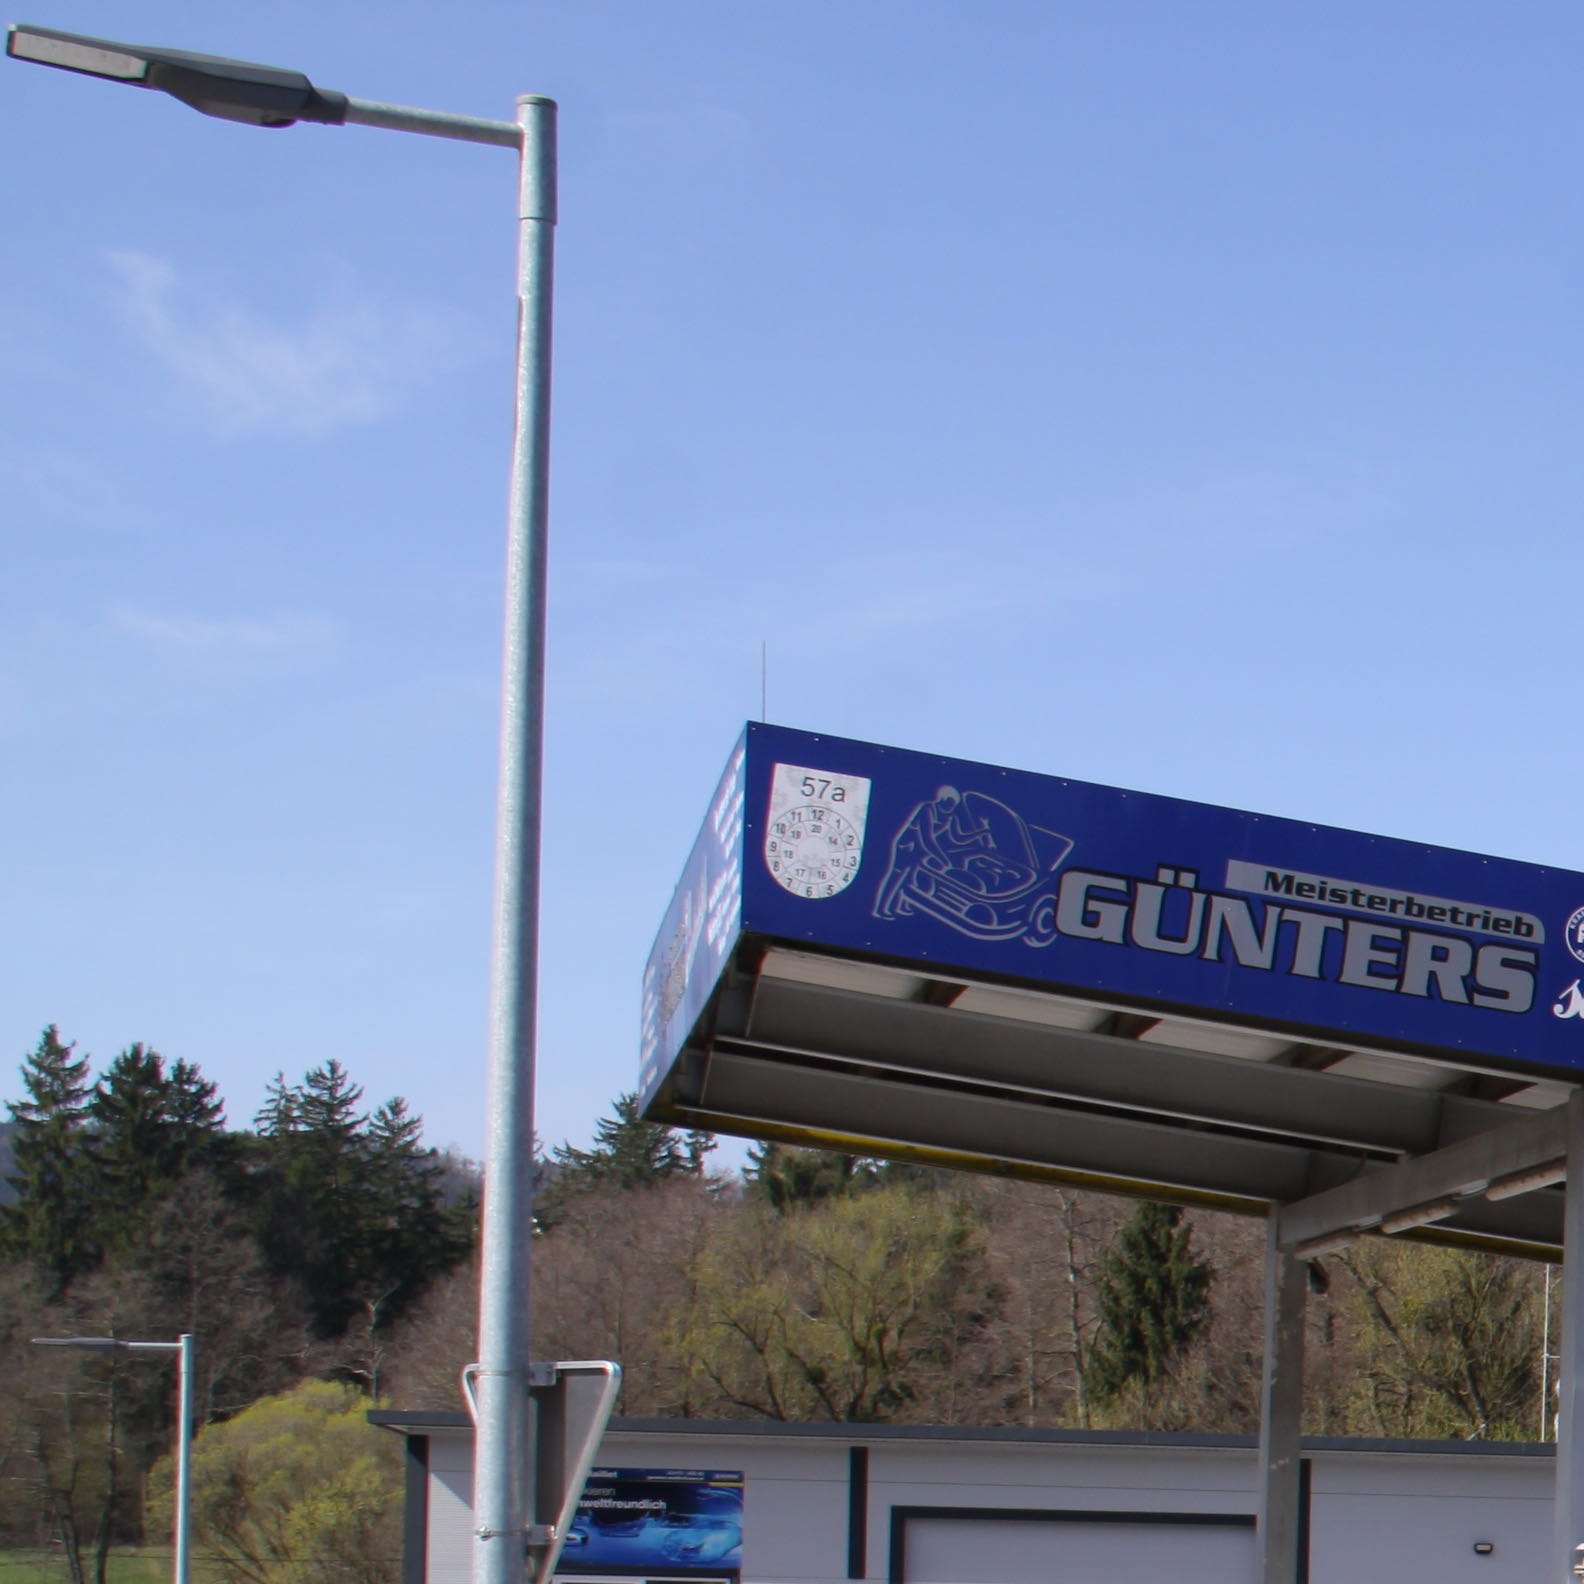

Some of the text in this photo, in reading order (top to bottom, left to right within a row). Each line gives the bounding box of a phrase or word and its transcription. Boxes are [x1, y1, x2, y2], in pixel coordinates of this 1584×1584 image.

[801, 776, 846, 802] 57a
[791, 811, 802, 822] 11
[812, 809, 824, 821] 12
[847, 835, 854, 846] 2
[770, 841, 778, 852] 9
[850, 856, 857, 867] 3
[787, 878, 793, 888] 7
[806, 886, 813, 897] 6
[1264, 871, 1535, 938] Meisterbetrieb
[1054, 864, 1539, 1015] GÜNTERS
[579, 1498, 667, 1510] mweltfreundlich
